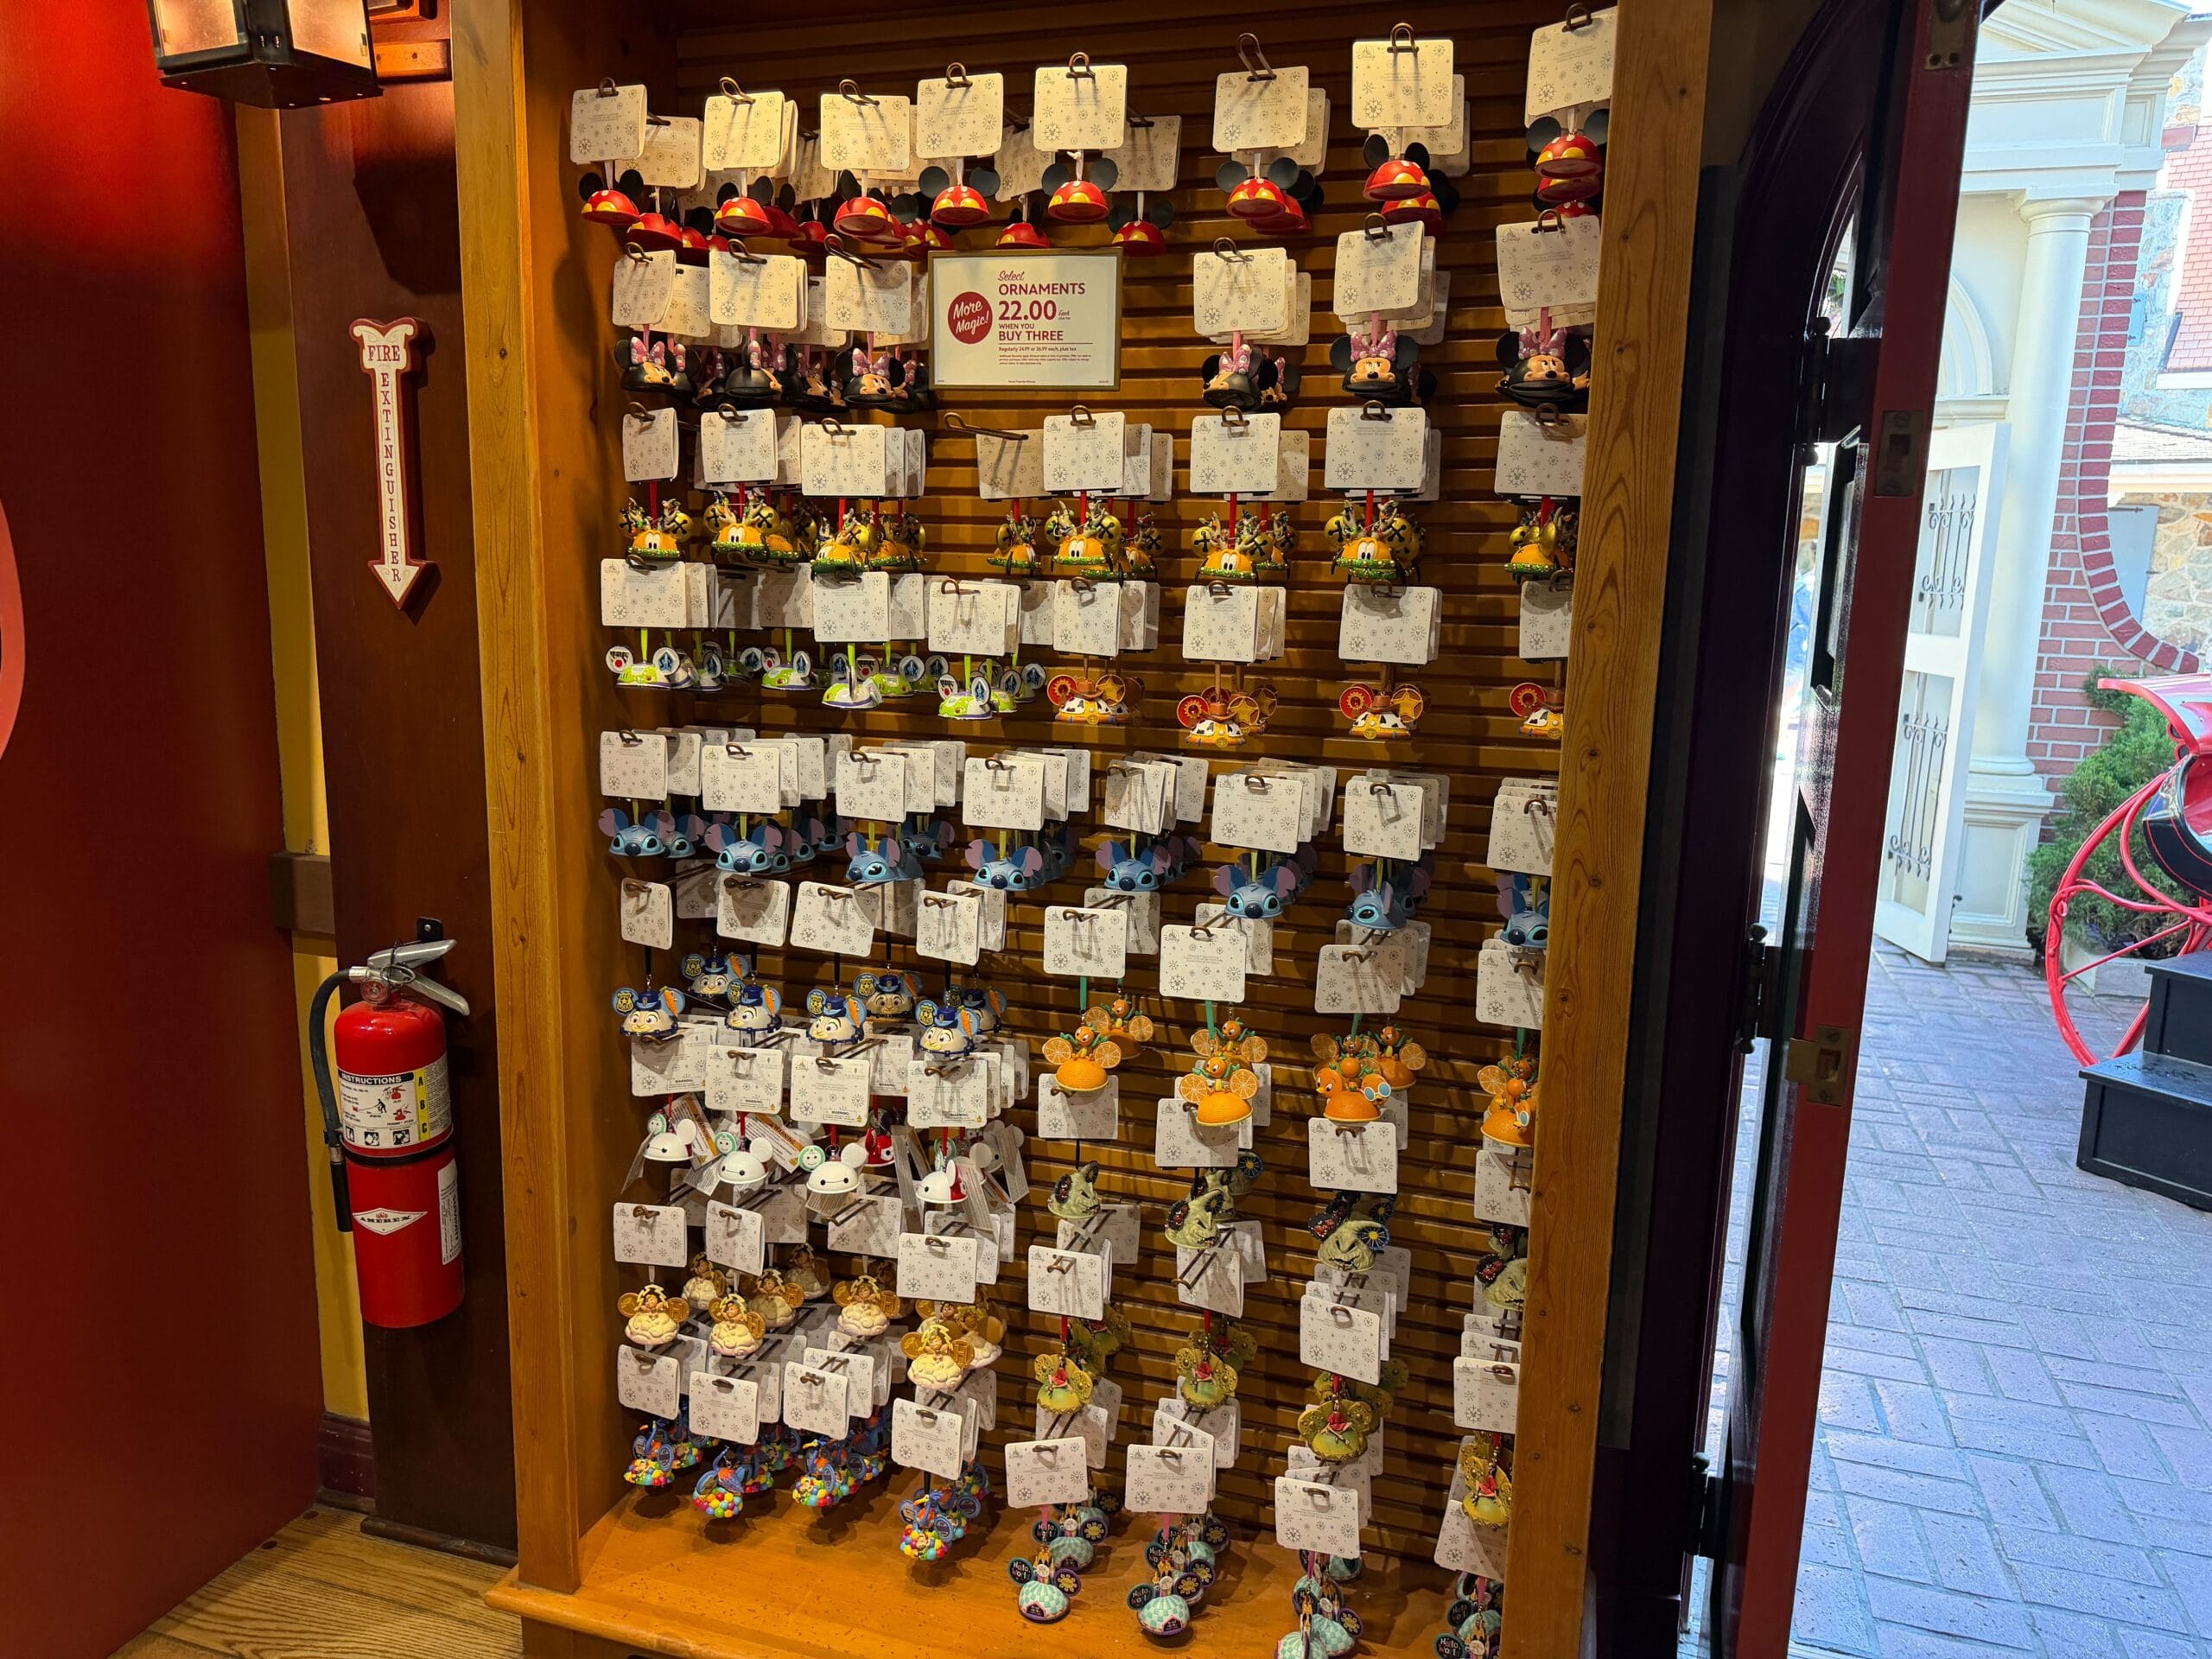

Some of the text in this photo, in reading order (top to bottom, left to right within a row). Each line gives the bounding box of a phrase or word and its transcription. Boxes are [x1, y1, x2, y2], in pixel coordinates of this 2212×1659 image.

[998, 270, 1025, 282] Select
[998, 283, 1086, 296] ORNAMENTS
[953, 301, 983, 320] More
[998, 300, 1057, 321] 22.00
[956, 310, 989, 335] Magic!
[998, 330, 1064, 341] BUY THREE
[367, 345, 401, 362] FIRE
[380, 372, 402, 582] EXTINGUISHER
[418, 1077, 423, 1086] A
[420, 1100, 426, 1109] B
[422, 1122, 428, 1133] C
